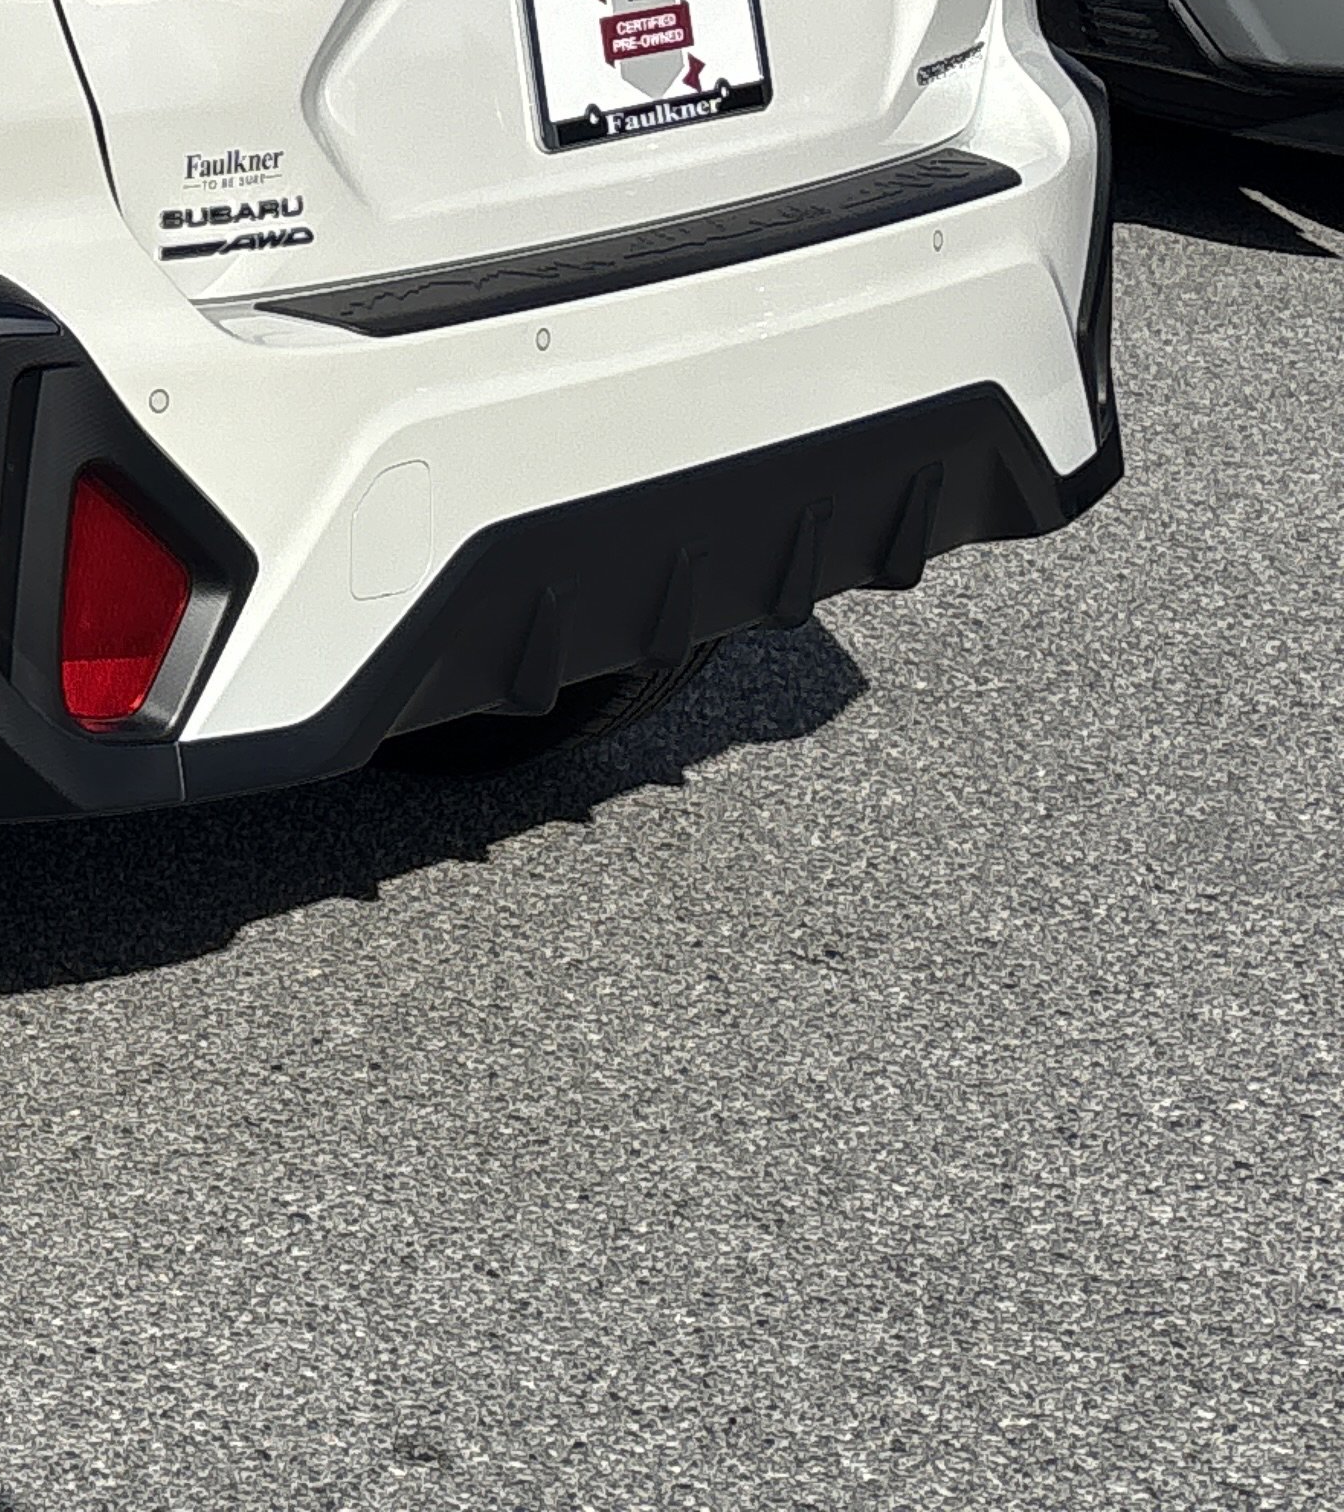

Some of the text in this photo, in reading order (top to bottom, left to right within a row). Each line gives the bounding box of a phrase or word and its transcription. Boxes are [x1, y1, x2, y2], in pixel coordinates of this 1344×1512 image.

[616, 13, 677, 35] CERTIFIED
[613, 28, 684, 53] PRE-OWNED
[605, 97, 722, 135] Faulkner
[184, 149, 285, 179] Faulkner
[202, 180, 218, 191] TO
[221, 177, 234, 188] BE
[159, 195, 304, 229] SUBARU
[218, 226, 315, 255] AWD
